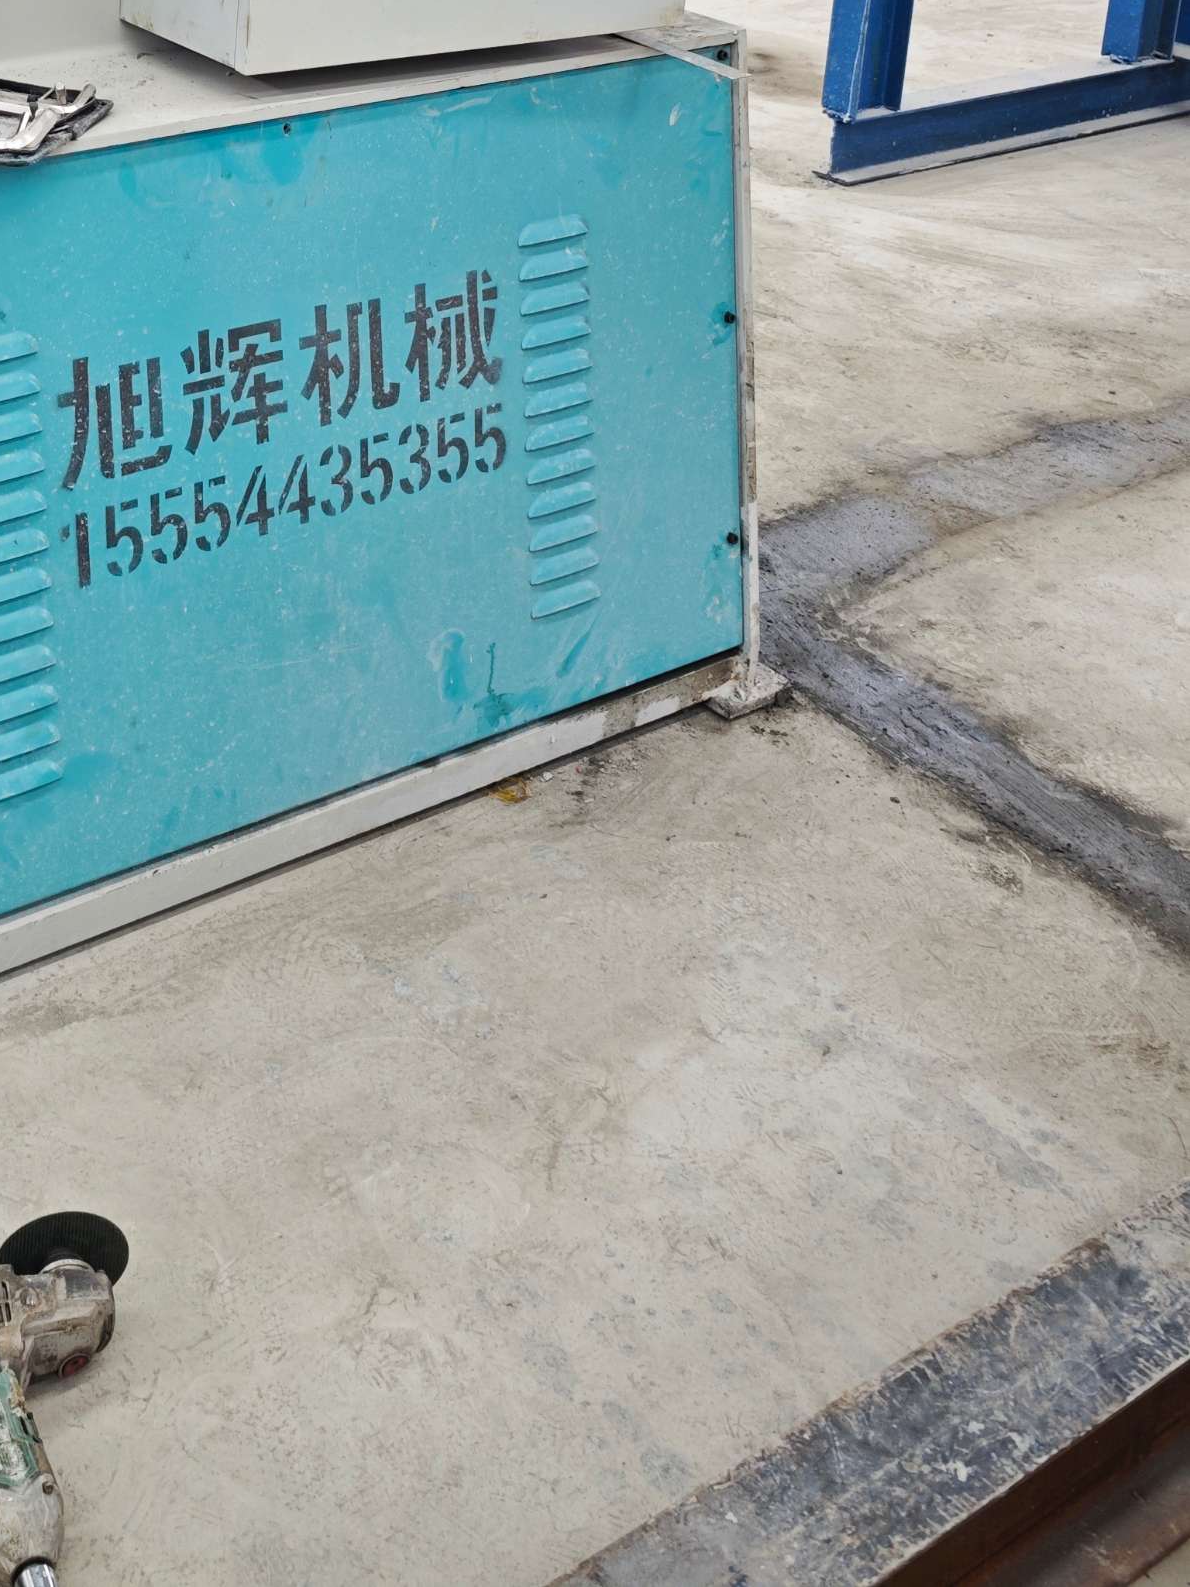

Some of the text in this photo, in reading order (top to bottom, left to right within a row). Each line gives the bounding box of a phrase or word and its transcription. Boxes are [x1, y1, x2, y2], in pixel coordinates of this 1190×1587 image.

[56, 269, 504, 491] 旭辉机械
[60, 402, 508, 589] 15554435355
